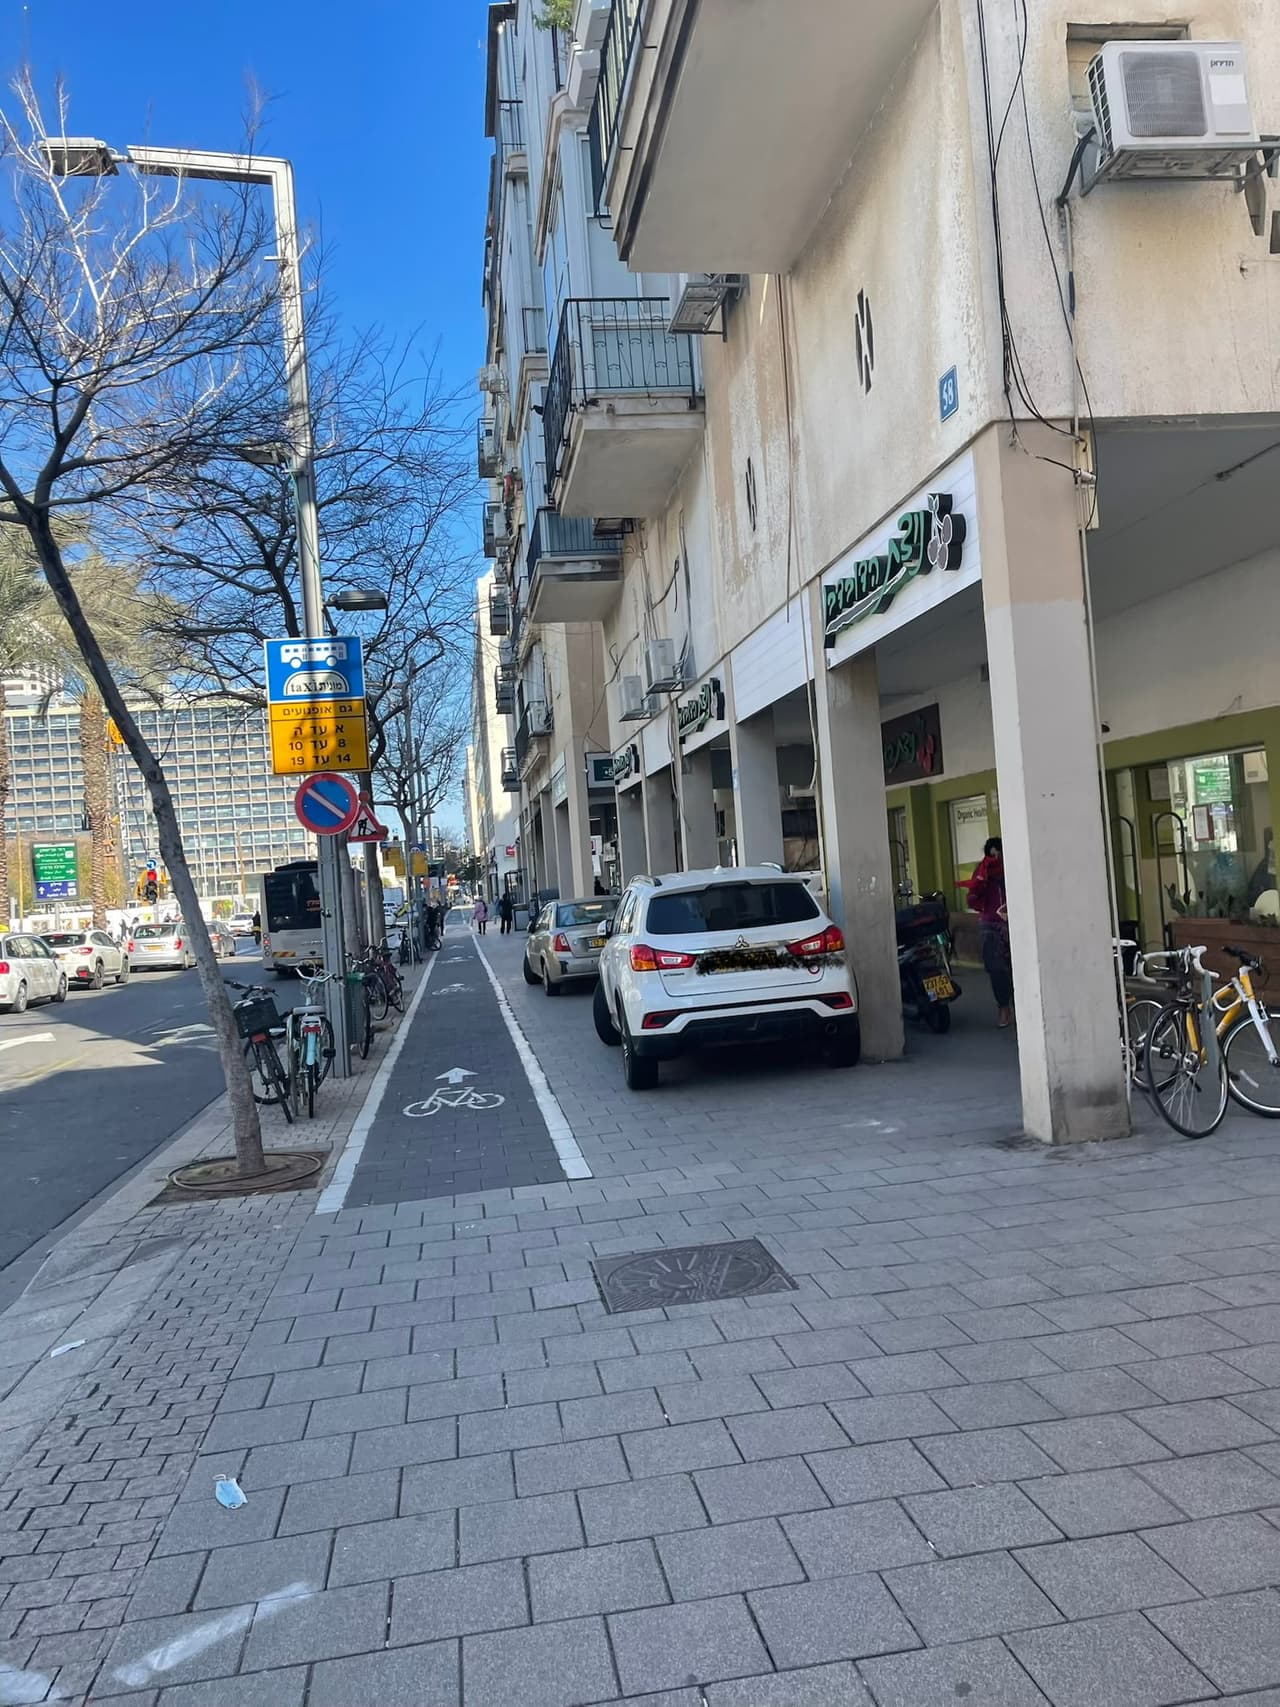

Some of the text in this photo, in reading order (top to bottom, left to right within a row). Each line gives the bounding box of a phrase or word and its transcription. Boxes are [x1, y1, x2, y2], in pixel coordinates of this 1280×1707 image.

[291, 679, 318, 692] taxi
[319, 681, 343, 691] מונית
[282, 704, 353, 716] גם אופנועים
[293, 724, 344, 738] א עד ה
[288, 739, 346, 751] 8 עד 10
[291, 753, 352, 766] 14 עד 19
